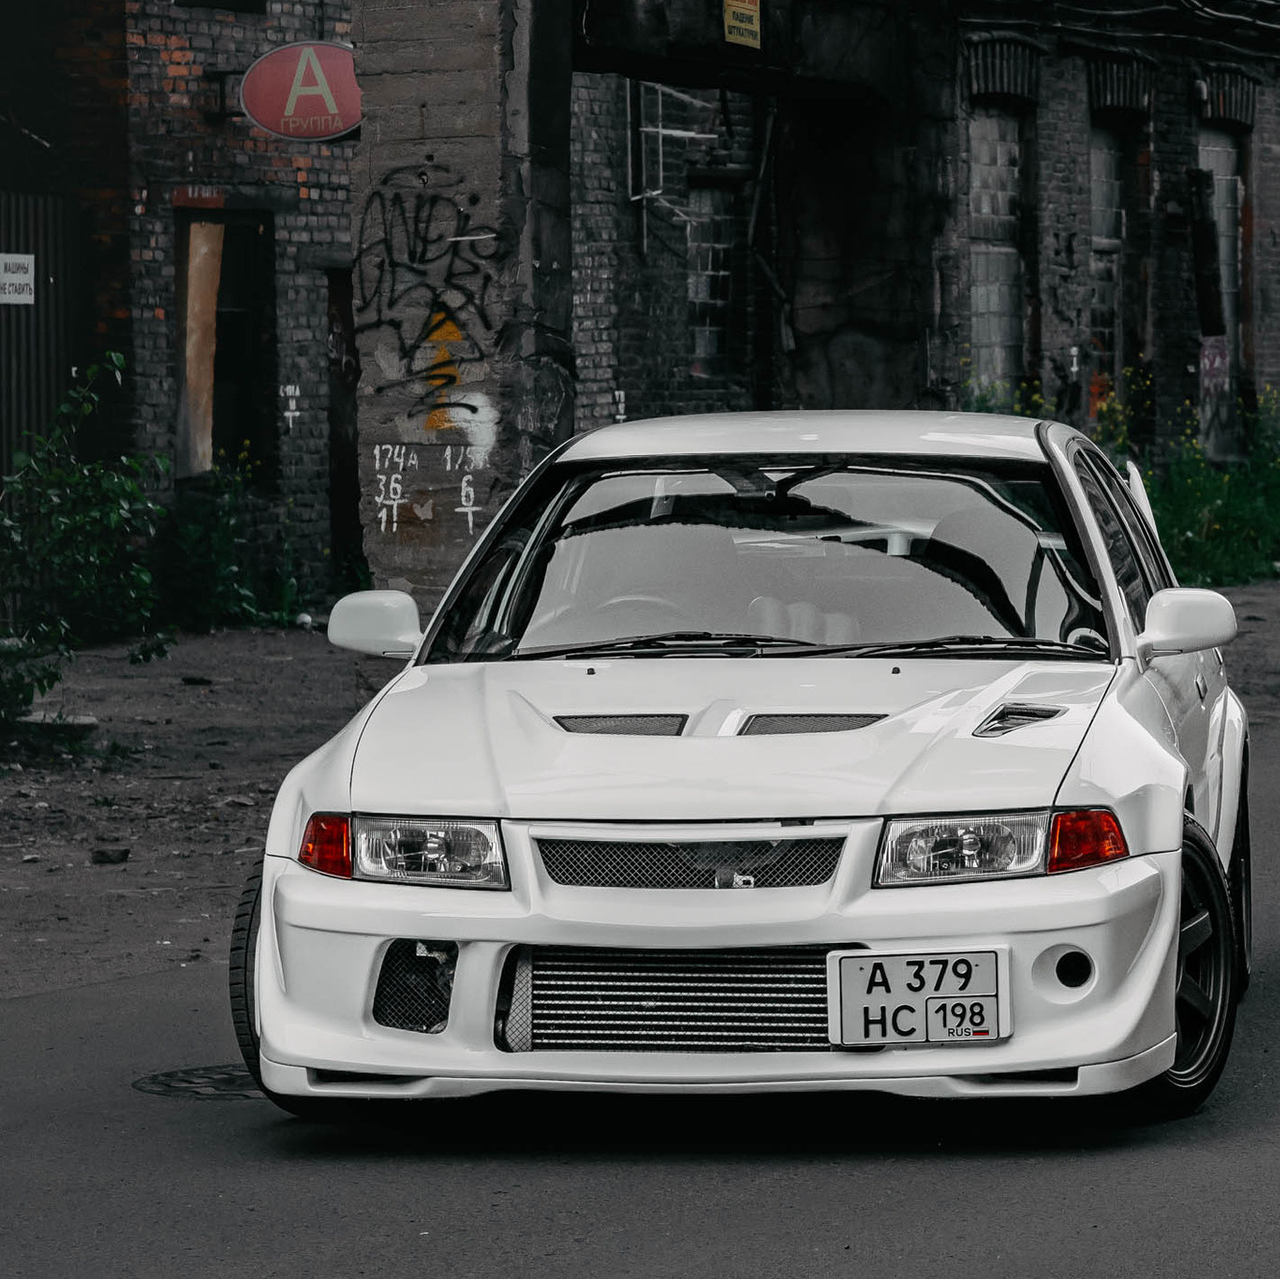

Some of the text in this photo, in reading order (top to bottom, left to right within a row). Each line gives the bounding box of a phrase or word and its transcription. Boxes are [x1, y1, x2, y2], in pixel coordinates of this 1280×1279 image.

[284, 47, 339, 116] А
[280, 115, 344, 134] ГРУППА
[906, 958, 973, 993] 379
[863, 1002, 986, 1040] НС 198
[947, 1027, 972, 1038] RUS
